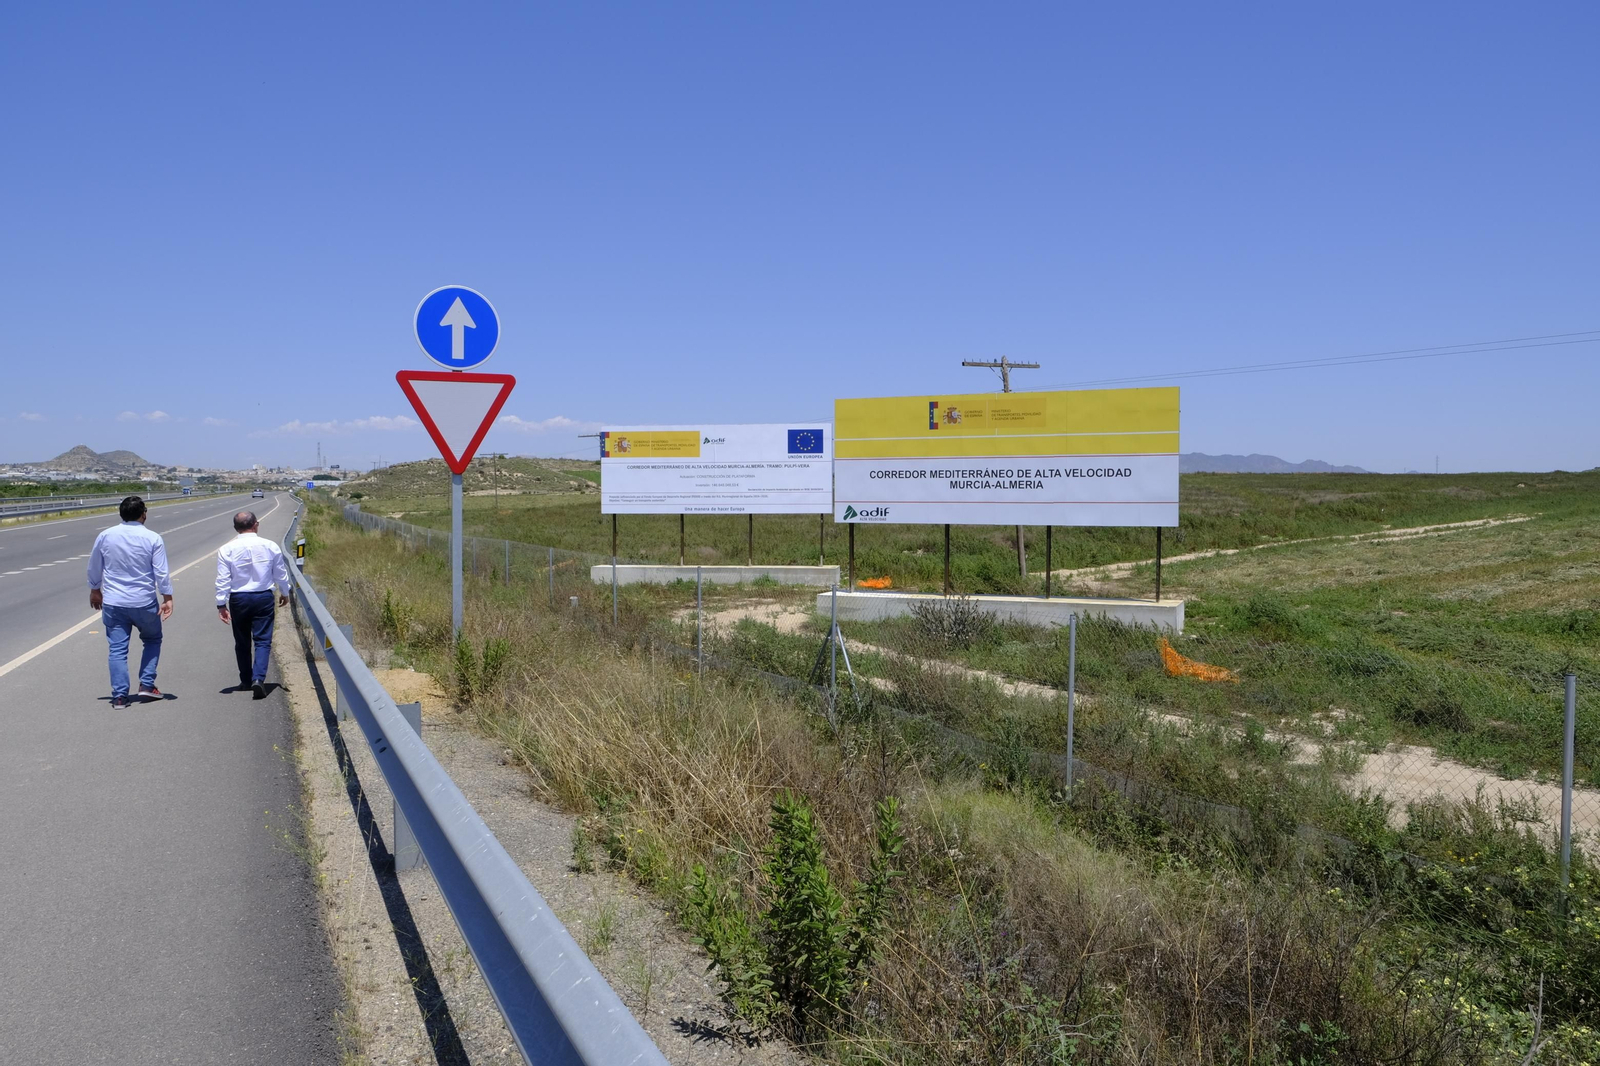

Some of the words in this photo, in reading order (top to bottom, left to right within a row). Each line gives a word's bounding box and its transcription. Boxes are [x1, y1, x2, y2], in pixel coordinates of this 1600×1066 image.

[870, 470, 927, 479] CORREDOR
[930, 468, 1014, 478] MEDITERRÁNEO
[1017, 470, 1032, 478] DE
[1034, 469, 1061, 478] ALTA
[1064, 468, 1132, 477] VELOCIDAD
[950, 480, 1044, 489] MURCIA-ALMERIA
[860, 507, 890, 516] adif
